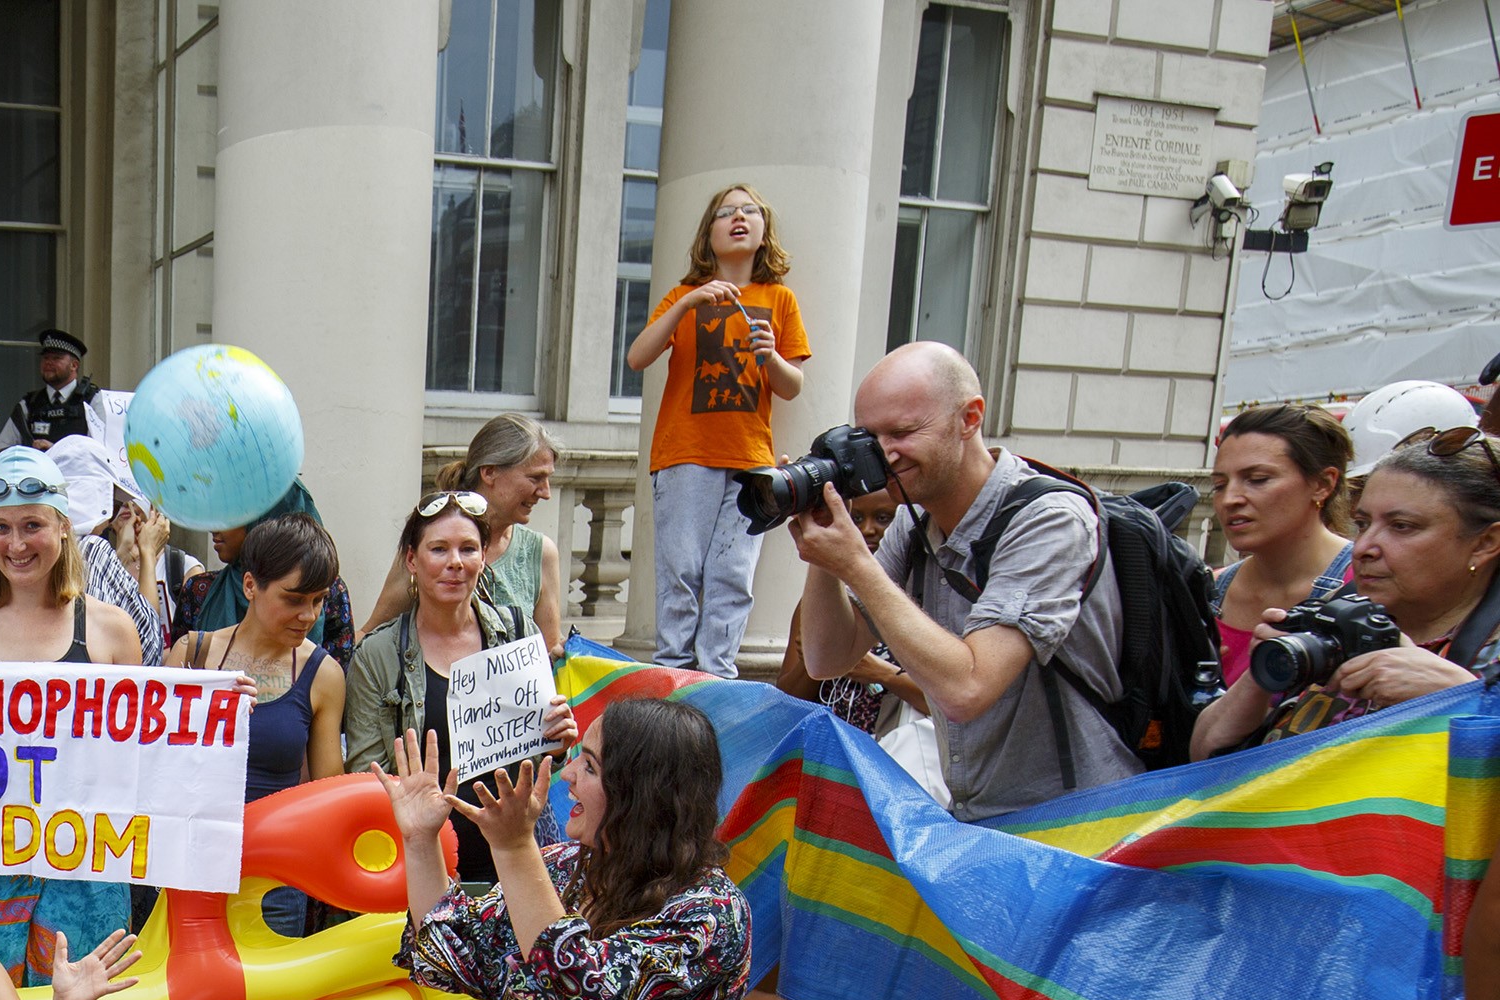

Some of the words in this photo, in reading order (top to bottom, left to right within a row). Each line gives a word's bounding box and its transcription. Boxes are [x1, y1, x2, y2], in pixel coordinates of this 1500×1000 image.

[1104, 133, 1151, 150] ENTENTE
[1155, 139, 1202, 156] CORDIALE
[47, 408, 64, 418] POLICE
[452, 669, 476, 695] Hey
[487, 640, 542, 680] MISTER!
[453, 697, 502, 733] Hands
[482, 708, 544, 748] SISTER!
